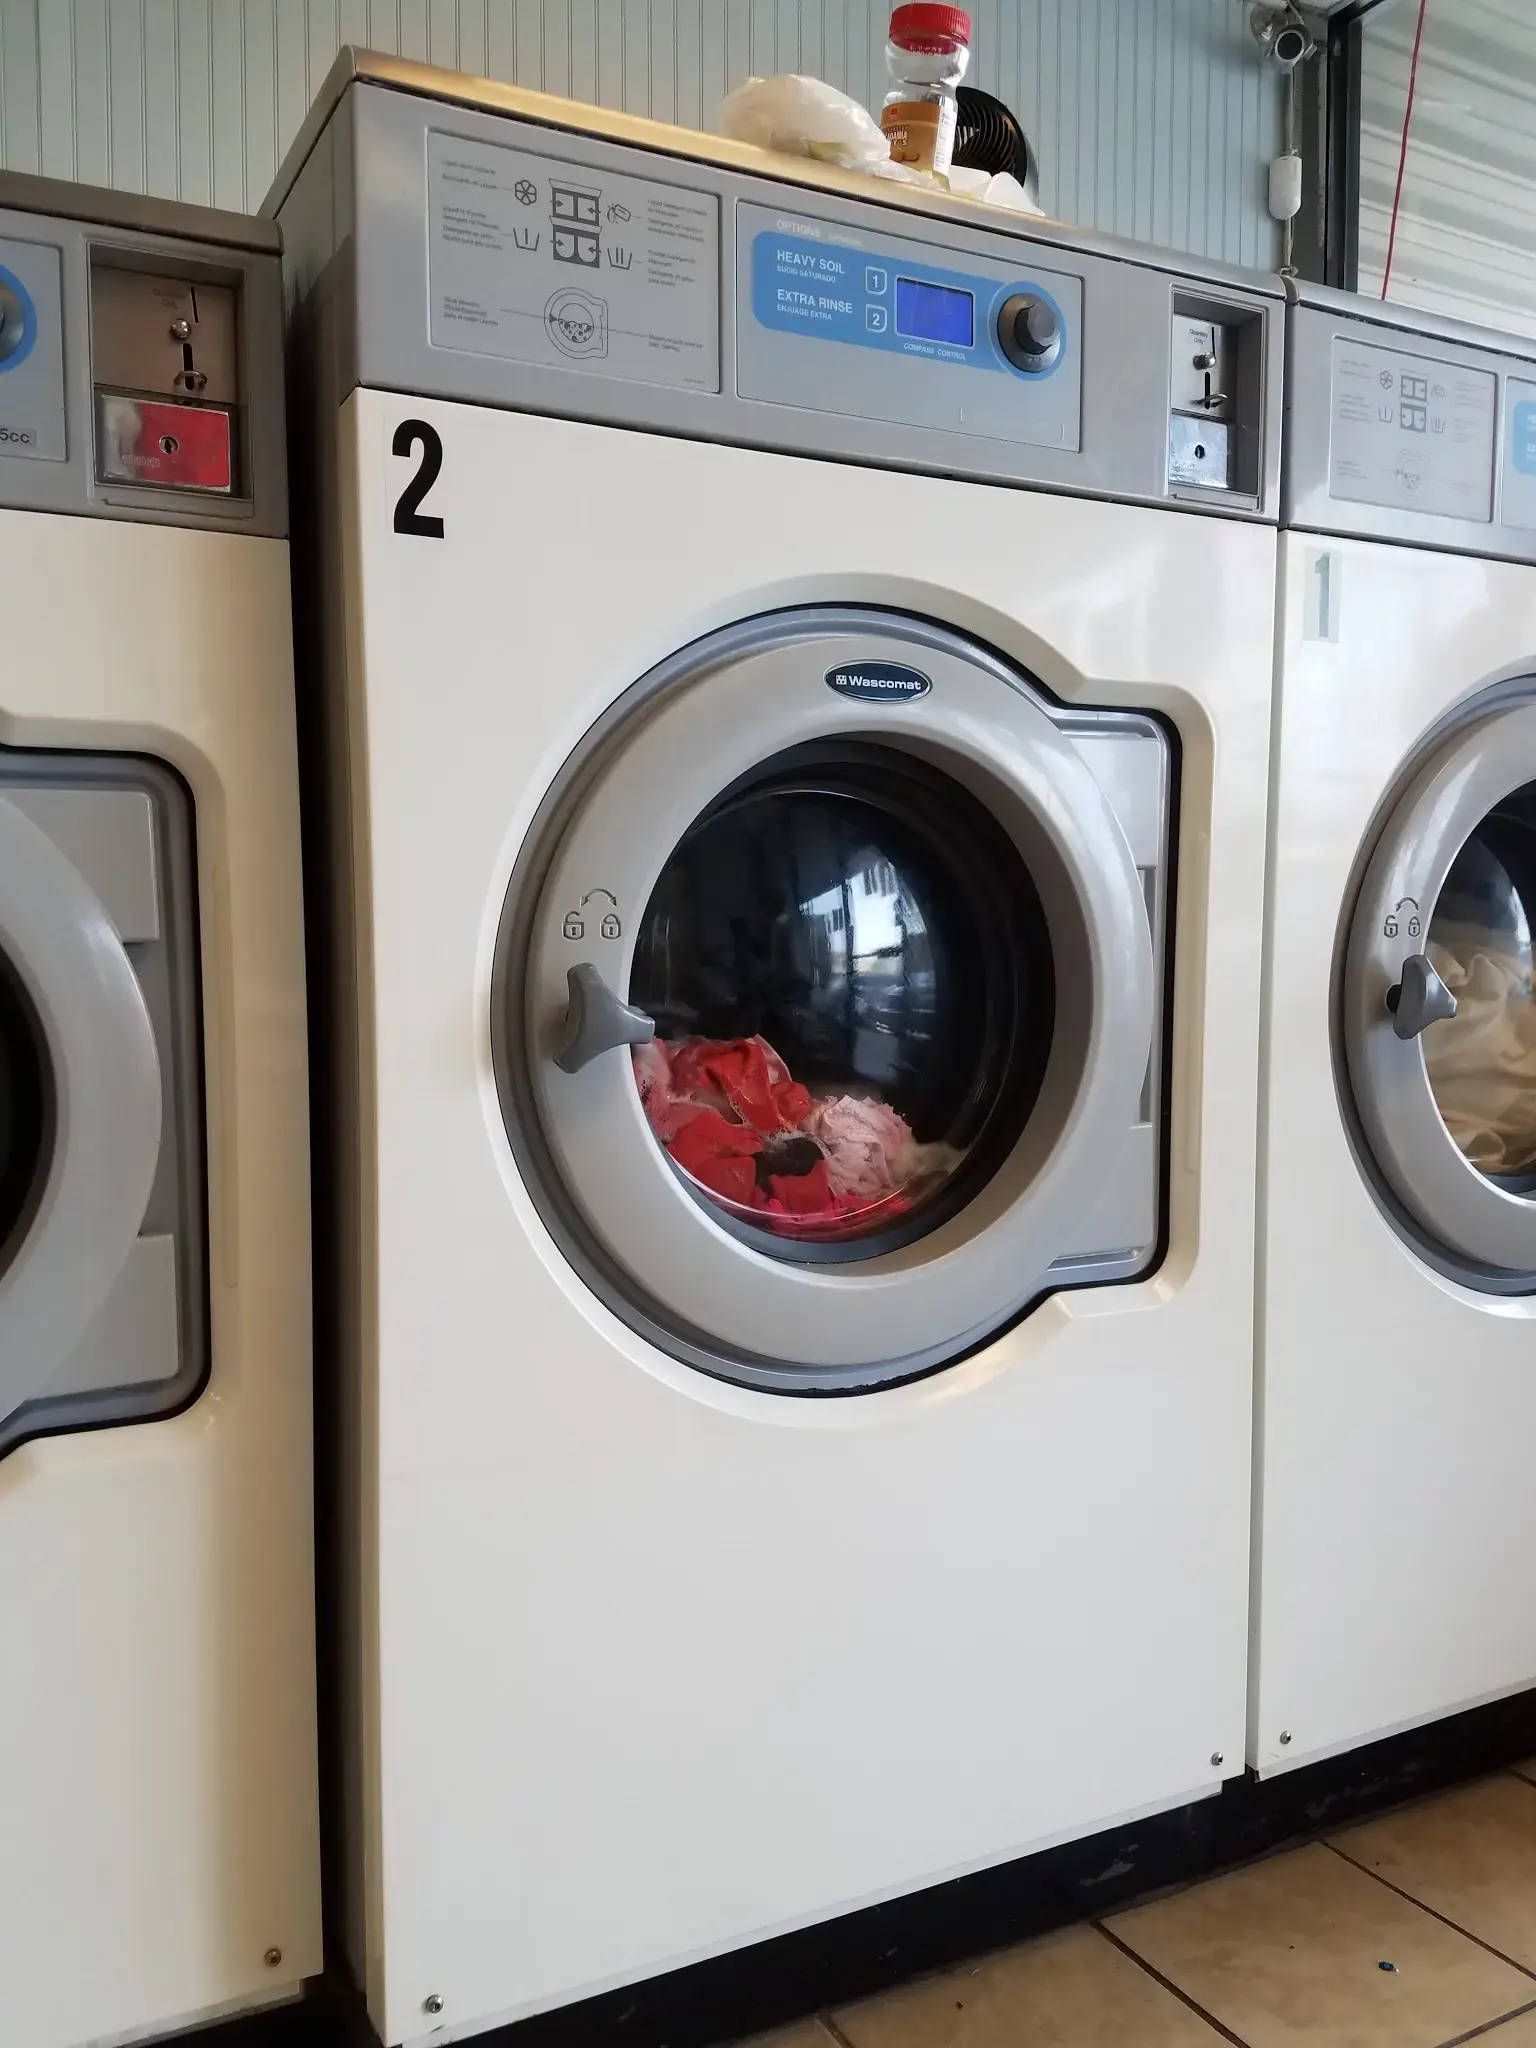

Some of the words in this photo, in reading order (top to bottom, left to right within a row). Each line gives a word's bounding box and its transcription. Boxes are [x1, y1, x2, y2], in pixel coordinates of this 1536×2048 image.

[777, 220, 821, 237] OPTIONS
[777, 250, 816, 268] HEAVY
[819, 258, 845, 274] SOIL
[777, 265, 798, 276] SUCIO
[800, 270, 836, 283] SATURADO
[872, 275, 878, 288] 1
[777, 289, 816, 306] EXTRA
[819, 297, 853, 314] RINSE
[777, 304, 809, 317] ENJUAGE
[810, 310, 833, 321] EXTRA
[872, 312, 880, 326] 2
[903, 342, 935, 354] COMPASS
[937, 348, 967, 361] CONTROL
[0, 428, 30, 444] 5cc
[392, 419, 444, 539] 2
[1314, 552, 1330, 638] 1
[848, 675, 921, 690] Wascomat
